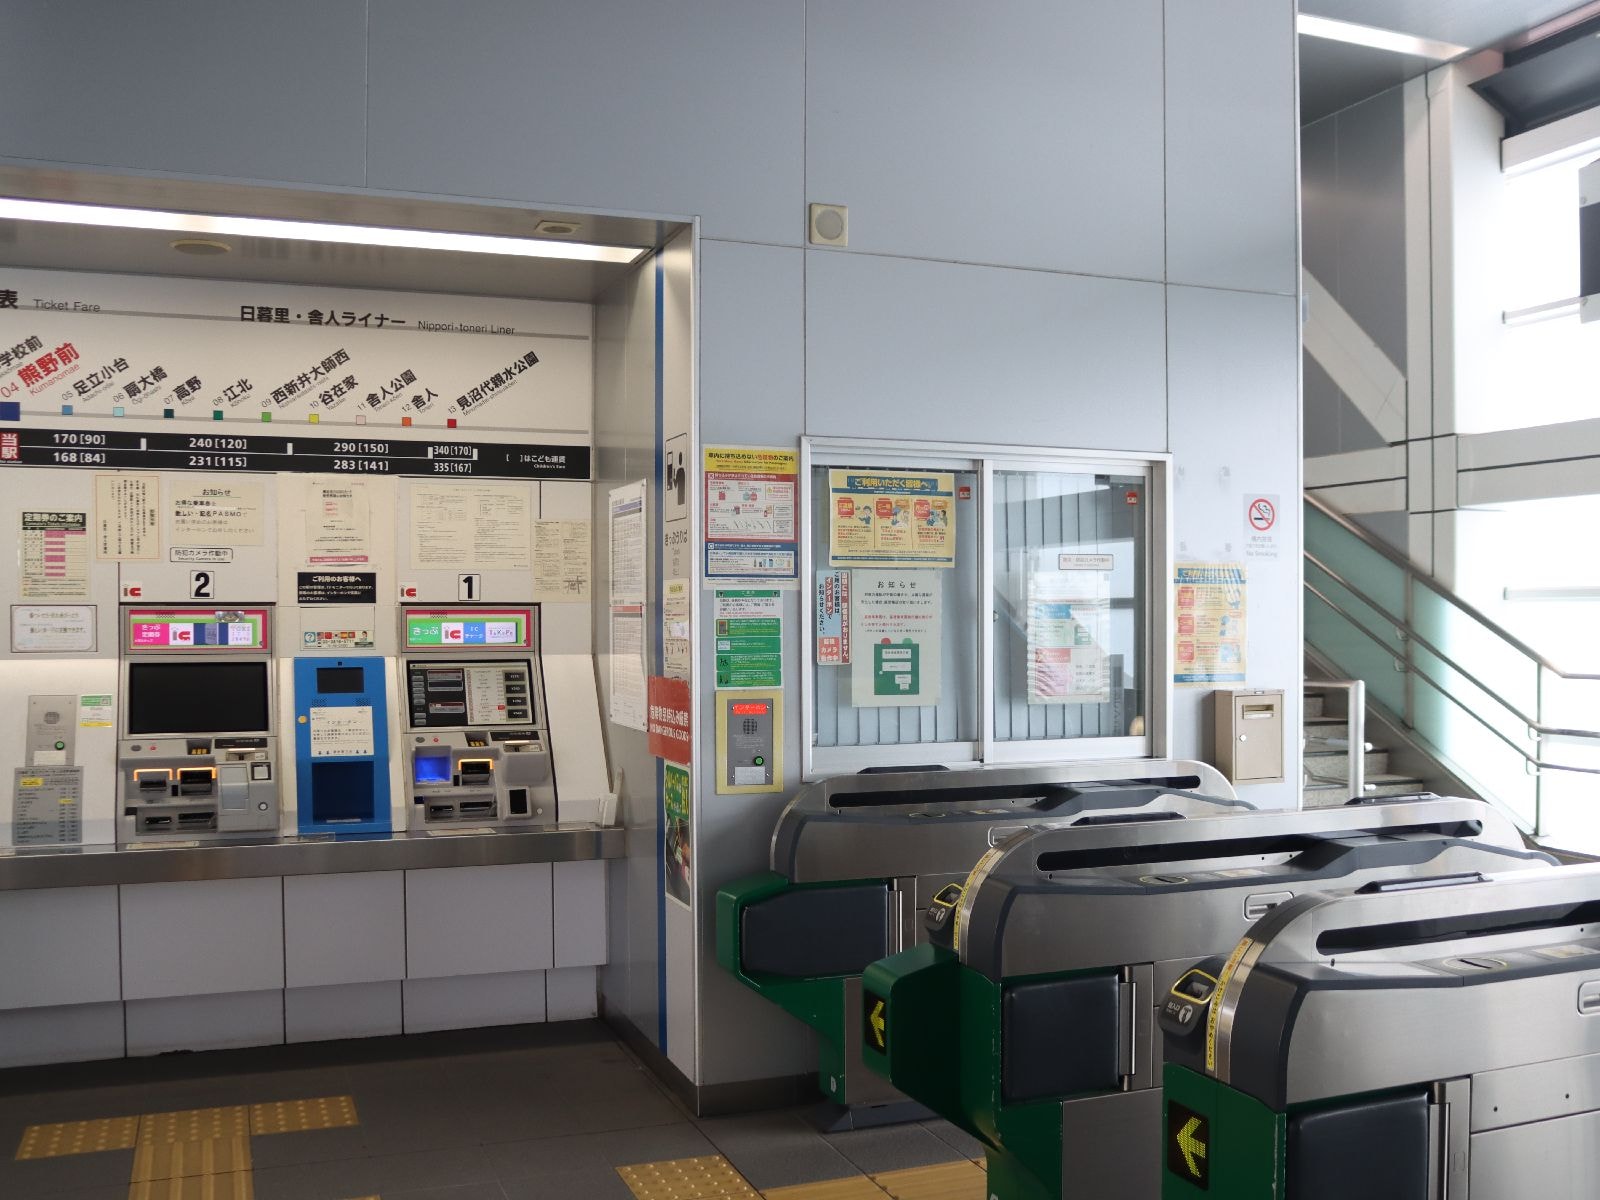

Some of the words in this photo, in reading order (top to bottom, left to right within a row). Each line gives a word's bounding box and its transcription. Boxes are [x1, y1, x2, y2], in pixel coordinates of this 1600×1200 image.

[33, 299, 69, 310] Ticket
[73, 301, 101, 312] Fare
[240, 305, 406, 327] 日暮里・舎人ライナー
[491, 324, 515, 335] Liner
[0, 382, 19, 398] 04
[17, 342, 80, 388] 熊野前
[73, 357, 129, 396] 足立小台
[270, 348, 350, 404] 西新井大師西
[456, 350, 540, 411] 見沼代親水公園
[172, 376, 201, 400] 高野
[223, 379, 252, 402] 江北
[319, 374, 358, 406] 谷在家
[366, 369, 417, 408] 舎人公園
[411, 388, 439, 409] 舎人
[1, 433, 18, 459] 当駅
[53, 433, 77, 444] 170
[79, 434, 106, 445] [90]
[189, 438, 213, 448] 240
[215, 439, 247, 449] [120]
[334, 442, 356, 453] 290
[358, 443, 389, 454] [150]
[53, 452, 77, 463] 168
[79, 453, 106, 464] [84]
[189, 455, 211, 466] 231
[215, 456, 247, 467] [115]
[433, 446, 449, 455] 340
[450, 446, 472, 456] [170]
[334, 459, 356, 470] 283
[358, 460, 389, 471] [141]
[433, 463, 449, 472] 335
[450, 463, 472, 473] [167]
[202, 488, 231, 496] お知らせ
[194, 572, 211, 598] 2
[463, 576, 474, 599] 1
[413, 626, 439, 637] きっぷ
